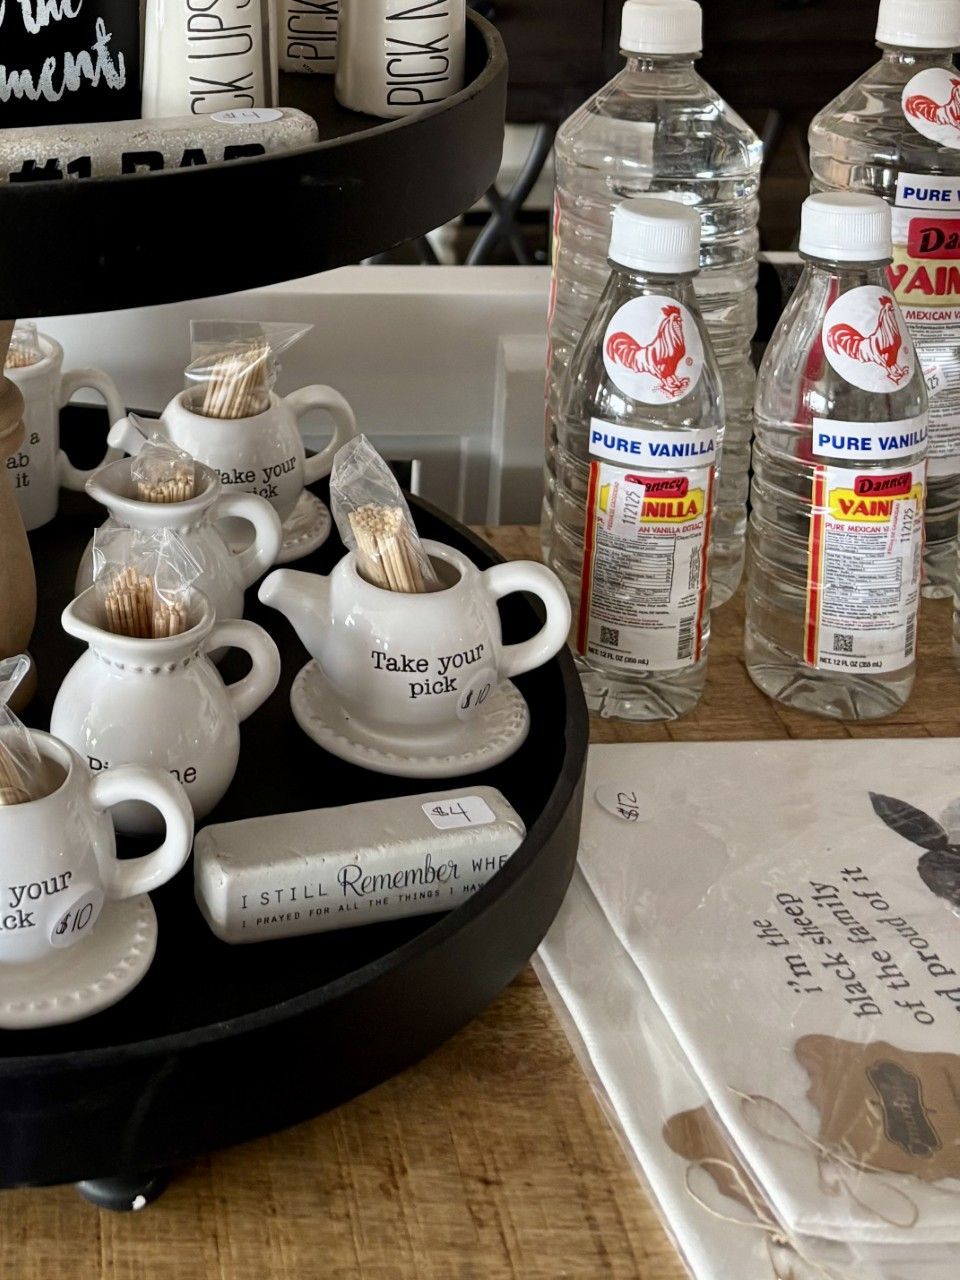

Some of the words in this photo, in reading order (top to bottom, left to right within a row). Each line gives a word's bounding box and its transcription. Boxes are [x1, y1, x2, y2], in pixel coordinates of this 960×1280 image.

[386, 33, 450, 107] PICK
[189, 71, 255, 116] CK
[902, 186, 952, 202] PURE
[906, 310, 952, 320] MEXICAN
[29, 432, 40, 445] a
[591, 430, 642, 455] PURE
[648, 438, 715, 458] VANILLA
[818, 432, 872, 451] PURE
[6, 452, 30, 469] ab
[262, 456, 297, 484] your
[15, 472, 30, 488] it
[638, 477, 686, 493] anncy
[652, 526, 681, 534] VANILLA
[825, 522, 846, 532] PURE
[847, 524, 881, 533] MEXICAN
[901, 507, 915, 543] 112125
[371, 649, 430, 674] Take
[437, 643, 485, 676] your
[408, 676, 458, 699] pick
[460, 682, 491, 710] $10
[430, 802, 472, 823] $4
[616, 791, 640, 822] $12
[241, 894, 248, 910] I
[259, 882, 328, 906] STILL
[336, 853, 461, 897] Remember
[471, 854, 509, 873] WHE
[840, 865, 869, 883] it
[8, 870, 73, 908] your
[852, 890, 890, 911] of
[256, 911, 301, 926] PRAYED
[309, 906, 331, 918] FOR
[338, 901, 359, 912] ALL
[369, 896, 389, 908] THE
[399, 888, 441, 903] THINGS
[463, 881, 485, 893] HAV
[809, 880, 878, 945] family
[55, 902, 93, 935] $10
[776, 892, 833, 946] sheep
[753, 918, 790, 948] the
[876, 915, 957, 978] proud
[784, 953, 824, 994] i'm
[871, 949, 911, 991] the
[821, 951, 884, 1018] black
[894, 999, 935, 1026] of
